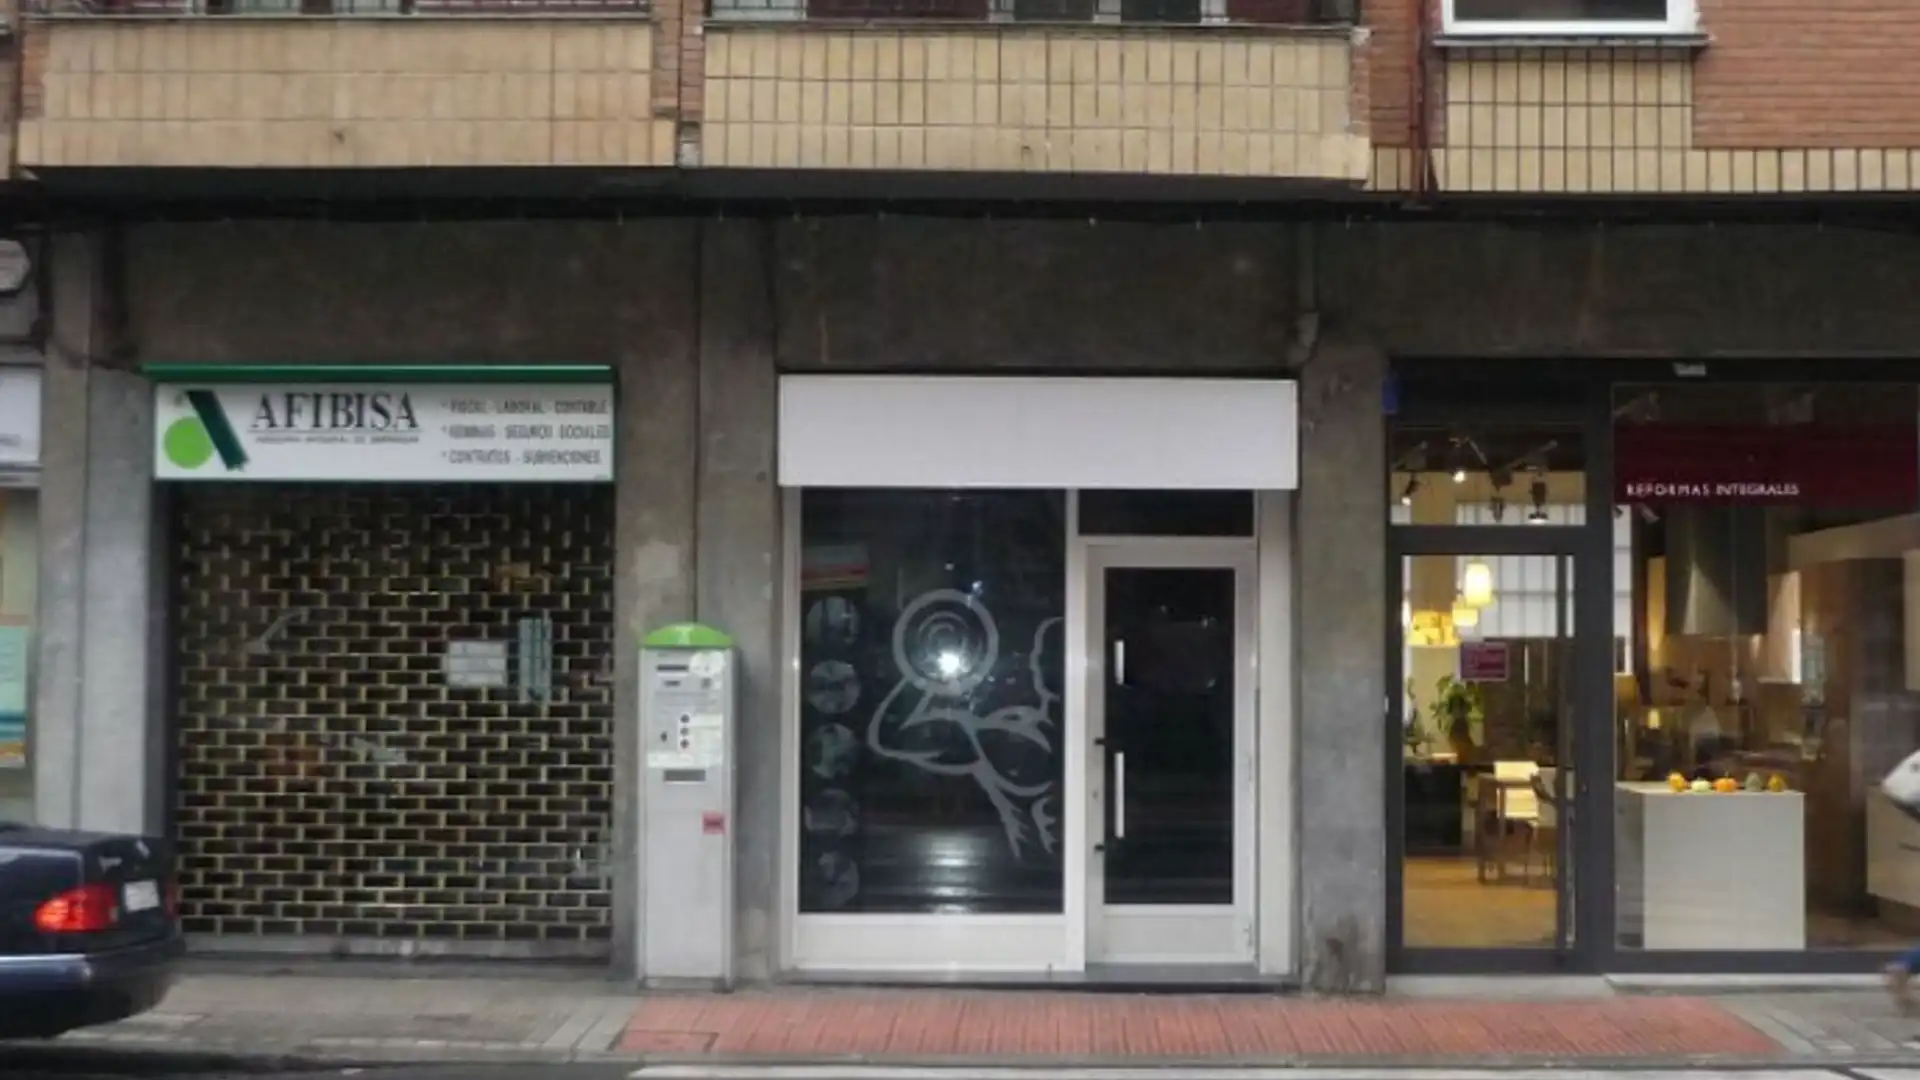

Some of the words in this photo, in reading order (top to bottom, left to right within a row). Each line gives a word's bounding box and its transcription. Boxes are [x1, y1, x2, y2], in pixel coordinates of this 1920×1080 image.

[251, 391, 419, 431] AFIBISA
[1626, 482, 1710, 497] REFORMAS
[1716, 482, 1800, 497] INTEGRALES
